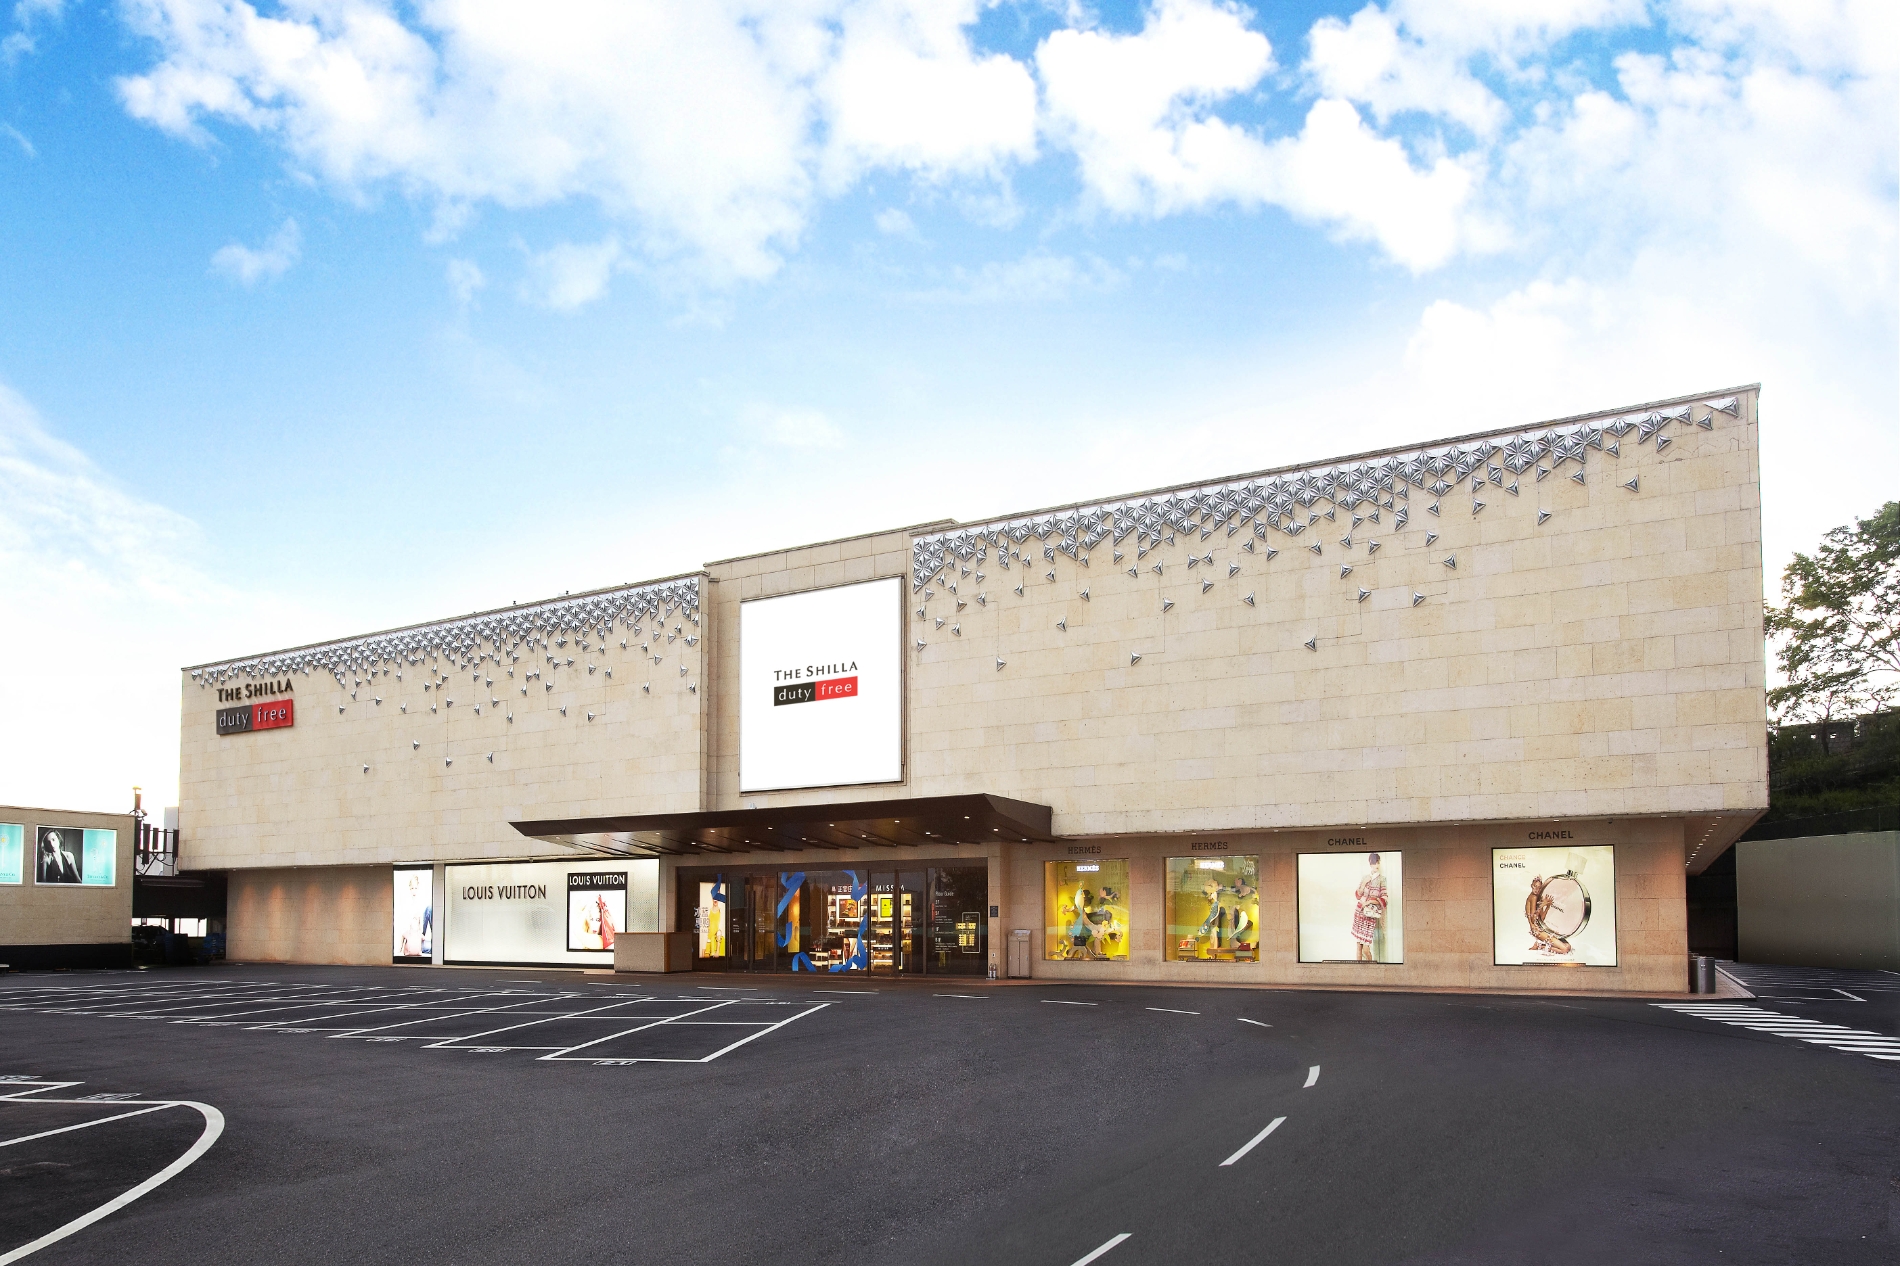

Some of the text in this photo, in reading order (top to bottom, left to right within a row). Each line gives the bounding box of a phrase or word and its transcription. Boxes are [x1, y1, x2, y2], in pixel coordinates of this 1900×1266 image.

[774, 661, 858, 681] THE SHILLA
[216, 678, 293, 702] THE SHILLA
[779, 683, 852, 701] duty free
[219, 706, 286, 729] duty free
[1327, 837, 1367, 846] CHANEL
[1528, 831, 1574, 840] CHANEL
[569, 874, 625, 885] LOUIS VUITTON
[462, 885, 547, 900] LOUIS VUITTON
[875, 884, 905, 892] MISSA
